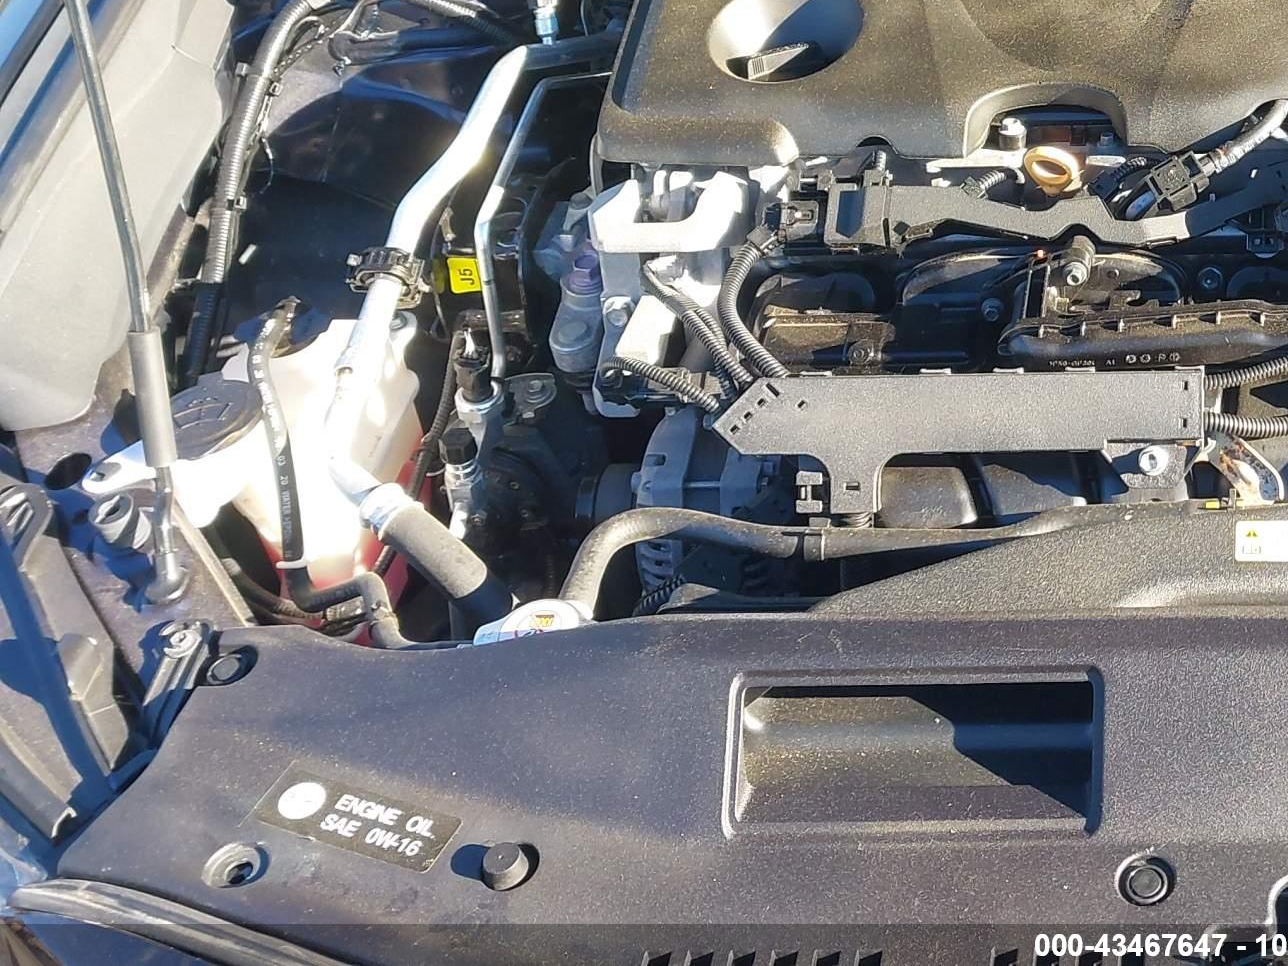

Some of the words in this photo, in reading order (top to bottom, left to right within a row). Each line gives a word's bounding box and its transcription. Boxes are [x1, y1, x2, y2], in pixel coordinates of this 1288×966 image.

[458, 268, 475, 286] J5
[335, 794, 403, 826] ENGINE
[319, 813, 362, 837] SAE
[365, 827, 423, 856] 0W-16
